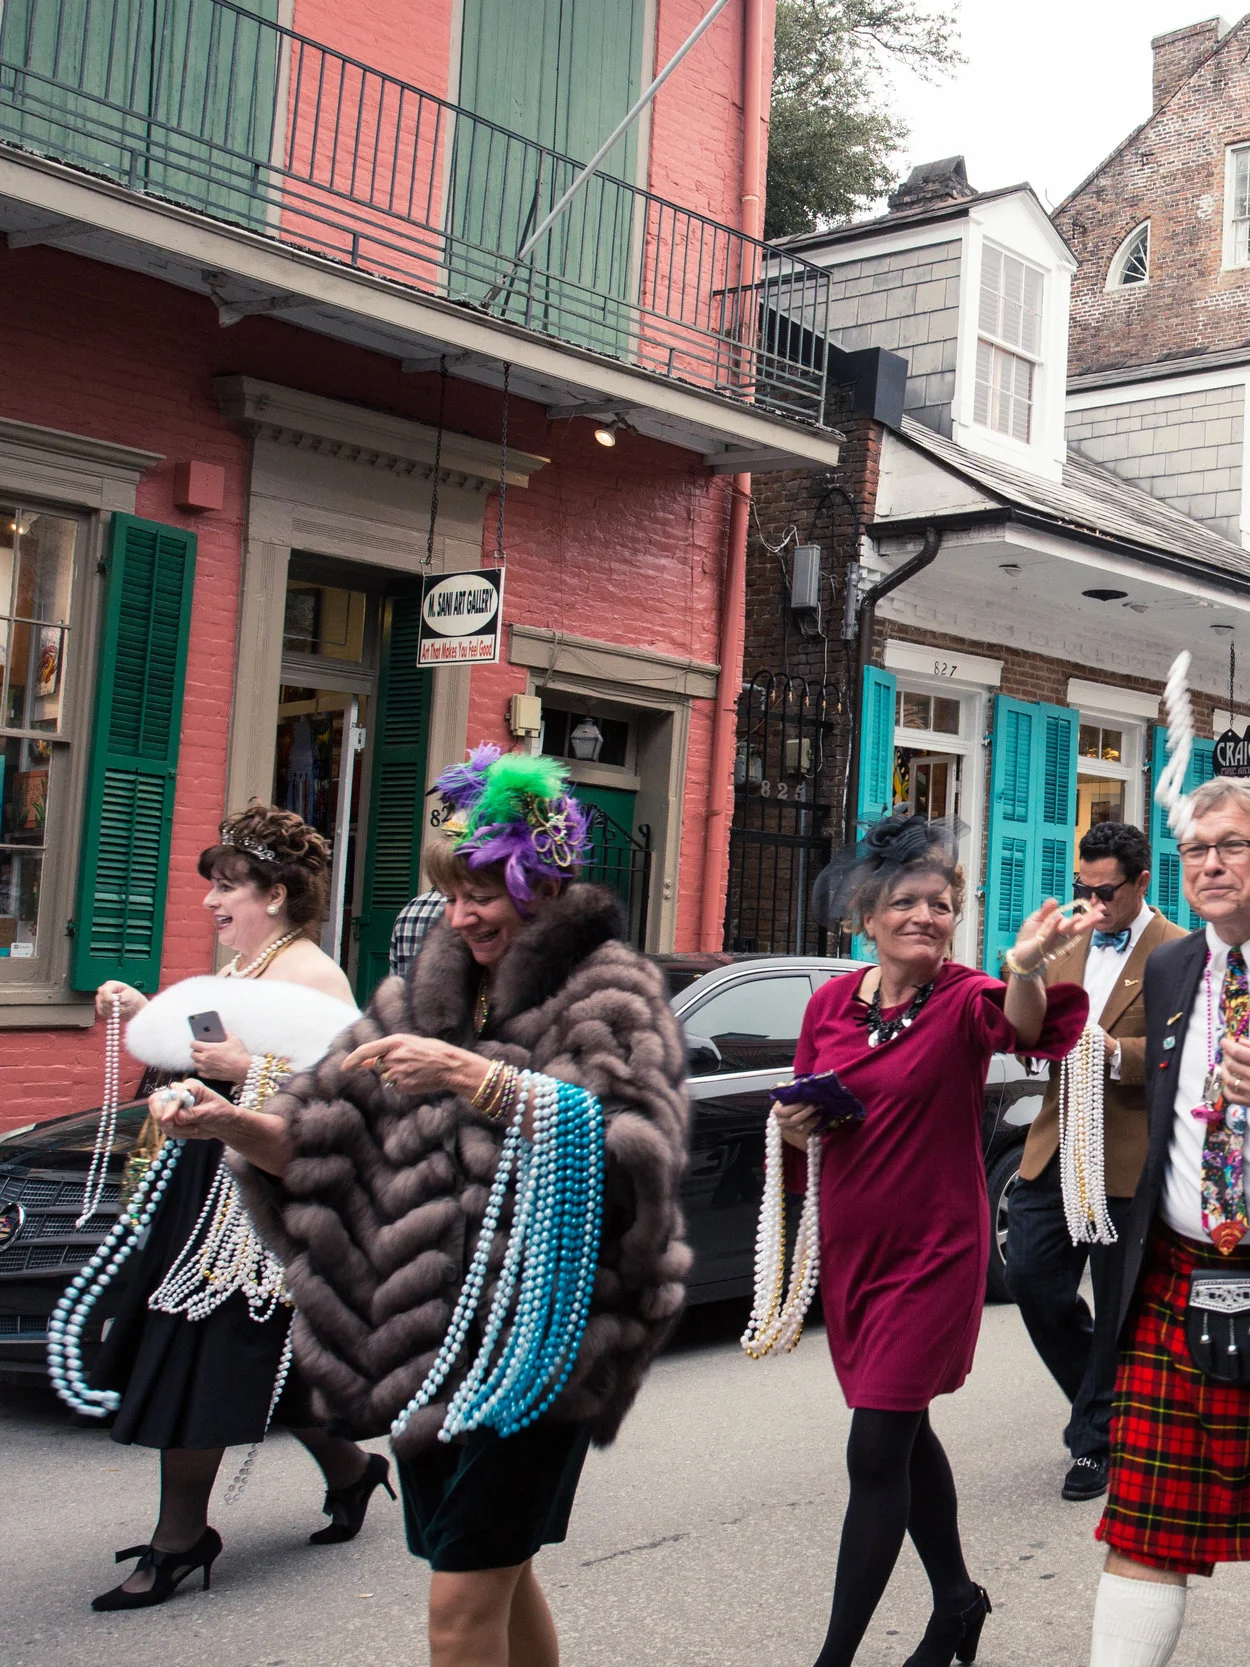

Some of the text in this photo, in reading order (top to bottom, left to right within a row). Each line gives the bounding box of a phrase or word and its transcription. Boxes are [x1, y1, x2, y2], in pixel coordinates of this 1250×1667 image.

[427, 588, 494, 617] M. SANI ART GALLERY
[422, 638, 493, 660] Art That Makes You Feel Good
[934, 661, 957, 678] 827
[1221, 766, 1236, 775] FINE
[1238, 766, 1250, 774] ART
[761, 780, 806, 802] 825
